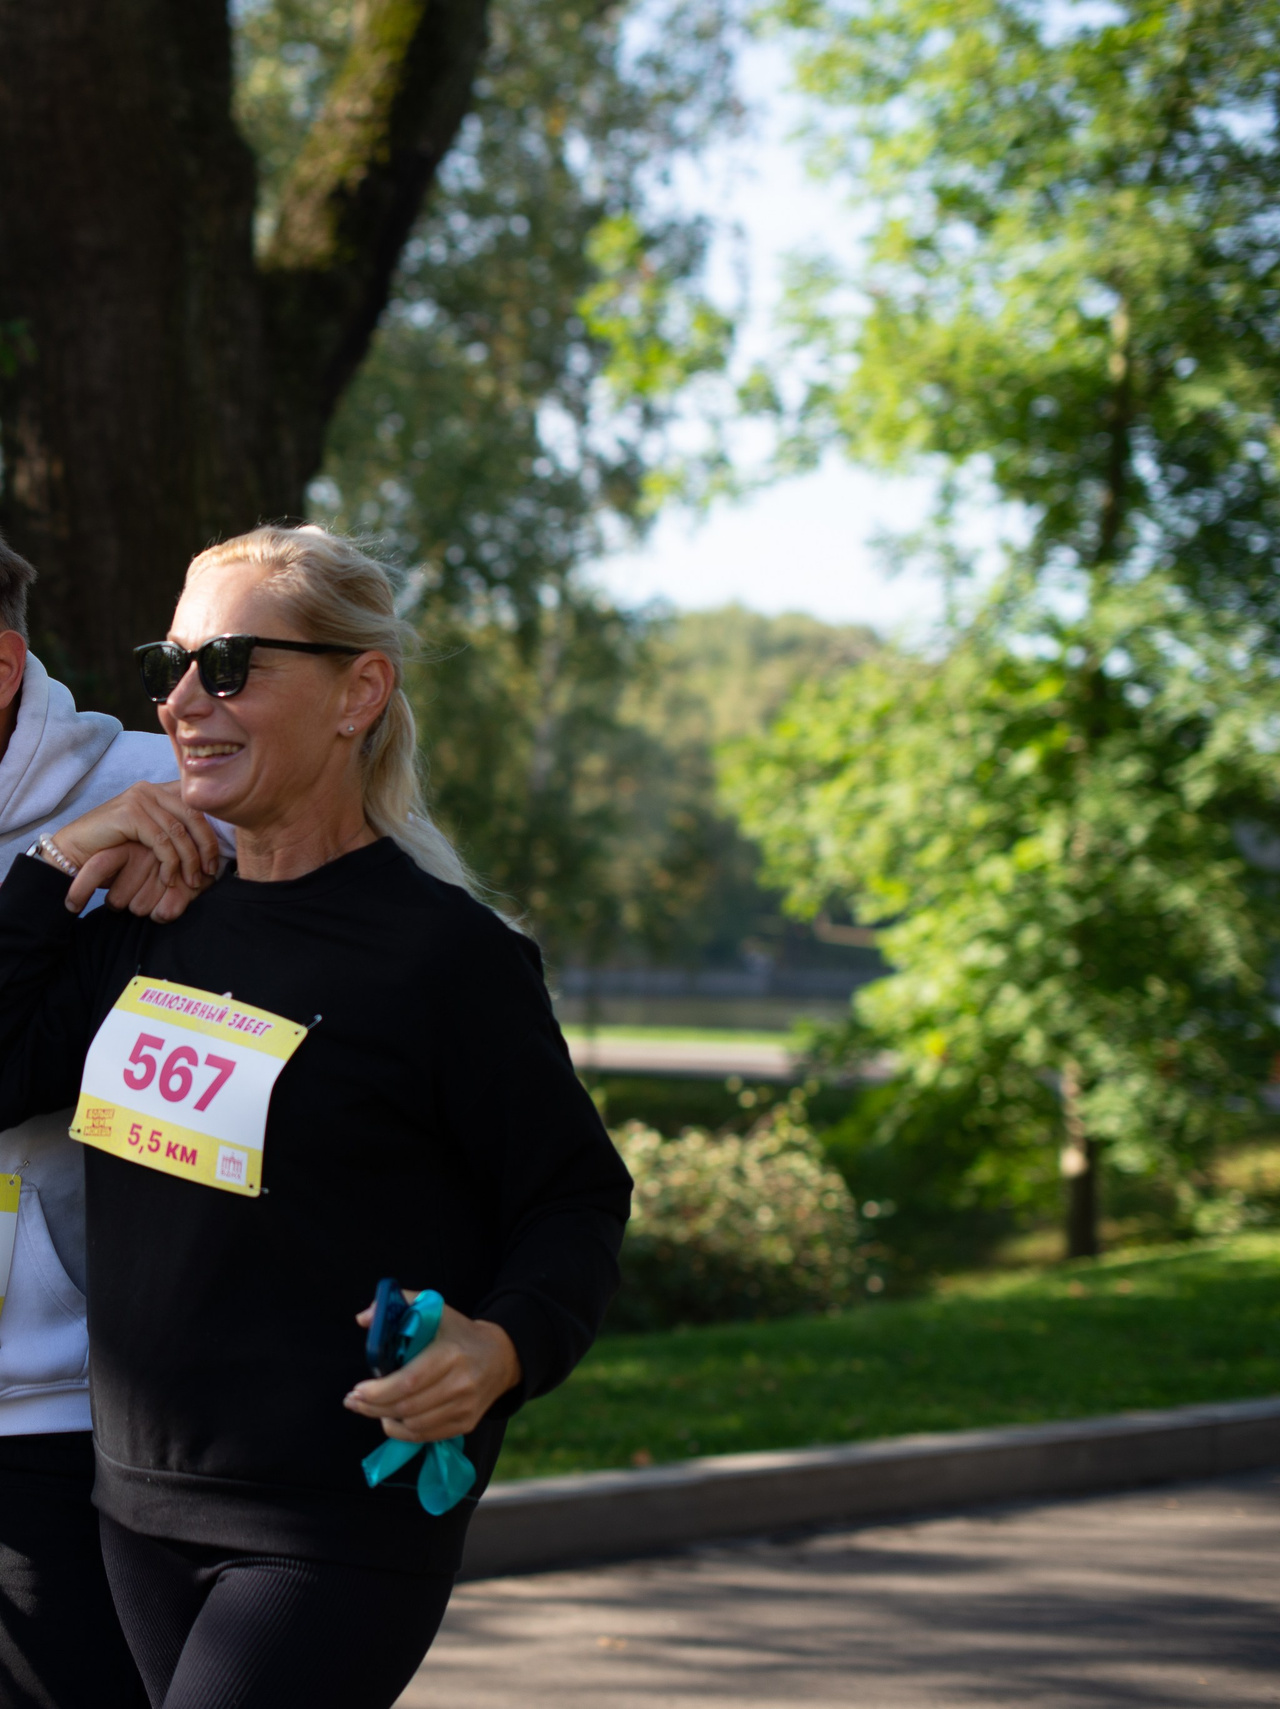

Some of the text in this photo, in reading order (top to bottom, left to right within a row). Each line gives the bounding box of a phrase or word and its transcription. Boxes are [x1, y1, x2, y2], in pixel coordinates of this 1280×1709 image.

[140, 989, 273, 1037] ИНКЛЮЗИВНЫЙ ЗАБЕГ
[122, 1032, 238, 1113] 567
[126, 1122, 164, 1156] 5,5
